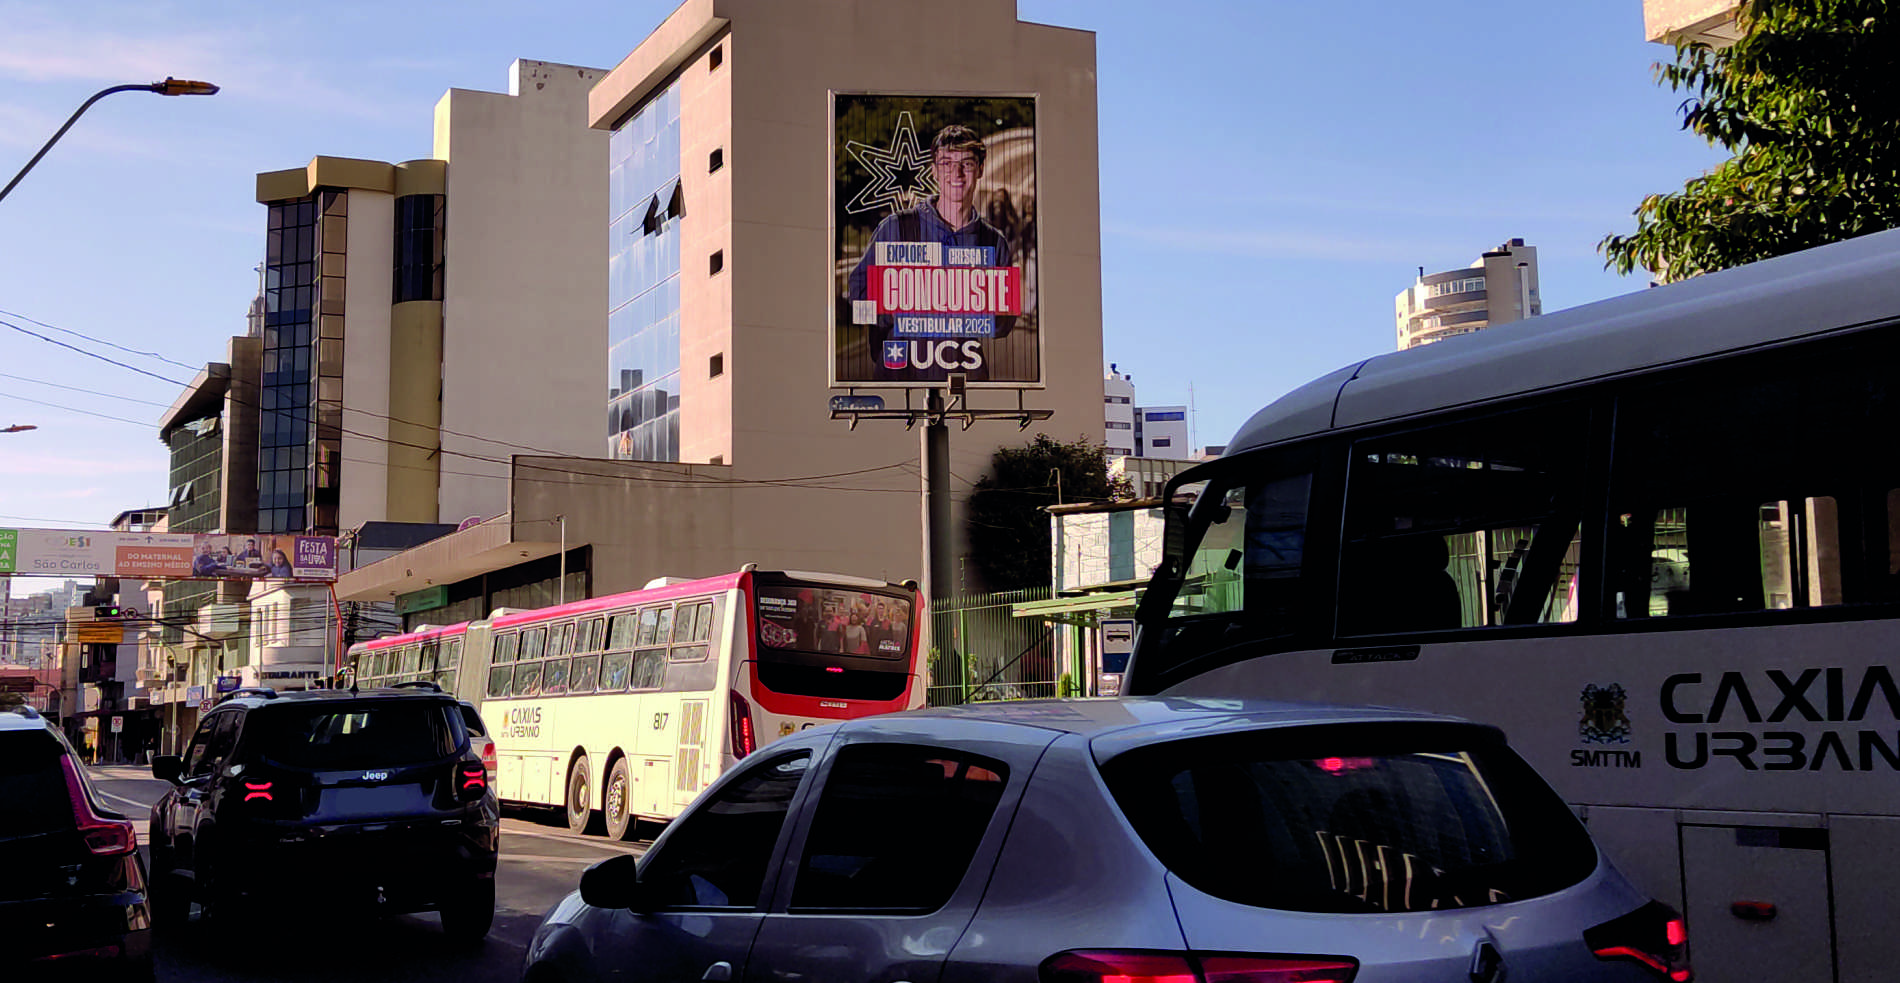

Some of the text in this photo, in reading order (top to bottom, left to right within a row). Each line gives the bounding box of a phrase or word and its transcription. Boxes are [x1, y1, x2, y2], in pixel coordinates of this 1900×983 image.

[886, 244, 988, 268] EXPLORE, CRESÇA E
[882, 267, 1010, 313] CONQUISTE
[897, 317, 991, 335] VESTIBULAR 2025
[910, 340, 983, 370] UCS
[141, 553, 182, 561] MATERNAL
[299, 540, 328, 556] FESTA
[34, 558, 100, 570] São Carlos
[511, 706, 542, 724] CAXIAS
[653, 712, 669, 731] 817
[510, 725, 540, 738] URBANO
[1570, 749, 1641, 768] SMTTM
[362, 770, 388, 781] Jeep
